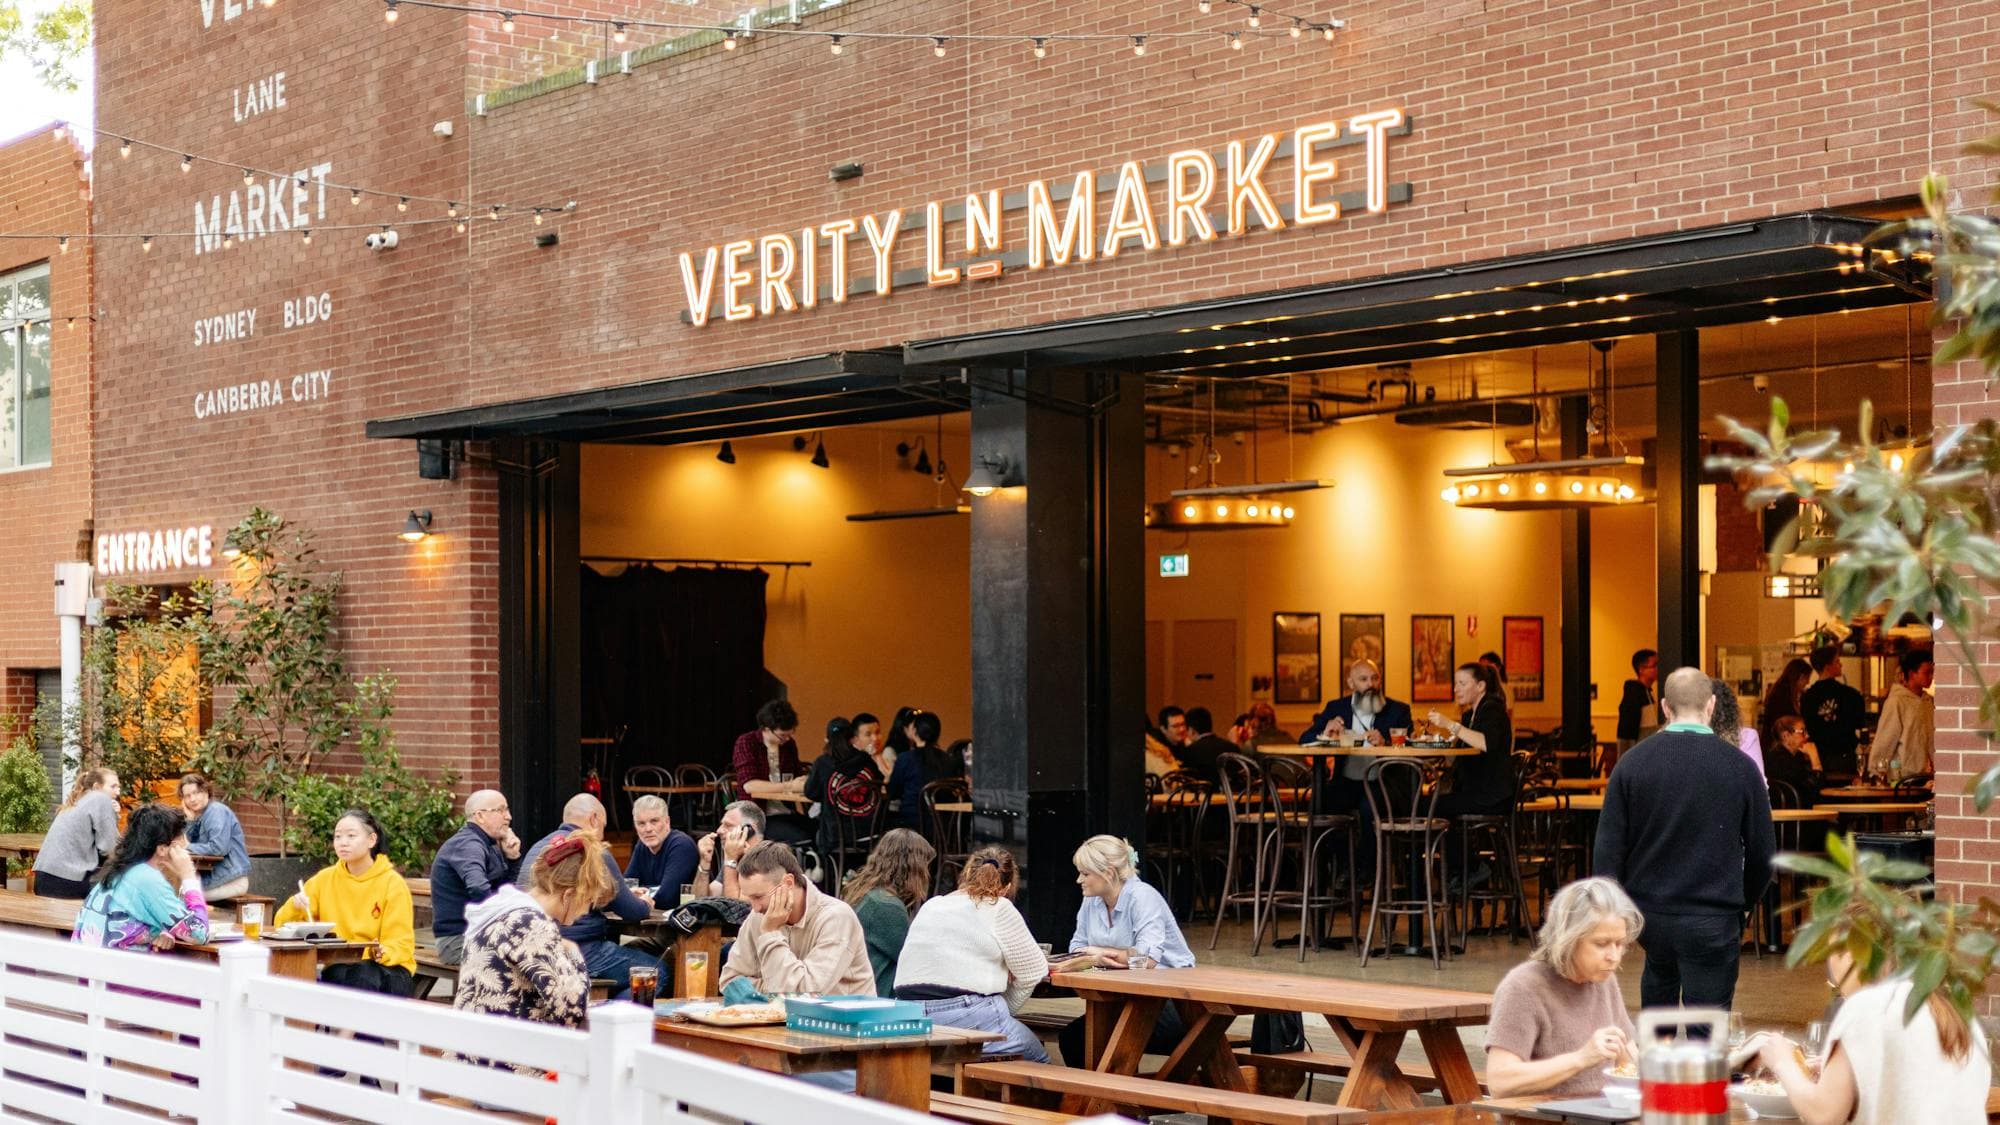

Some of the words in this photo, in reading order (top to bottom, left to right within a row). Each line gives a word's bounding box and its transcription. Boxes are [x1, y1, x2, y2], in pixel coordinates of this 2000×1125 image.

[233, 71, 287, 123] LANE
[194, 161, 332, 256] MARKET
[679, 207, 902, 328] VERITY
[1026, 107, 1405, 271] MARKET
[193, 308, 257, 347] SYDNEY
[283, 292, 332, 329] BLDG
[193, 379, 284, 420] CANBERRA
[291, 369, 332, 402] CITY
[97, 524, 213, 576] ENTRANCE
[798, 1018, 851, 1032] SCRABBLE
